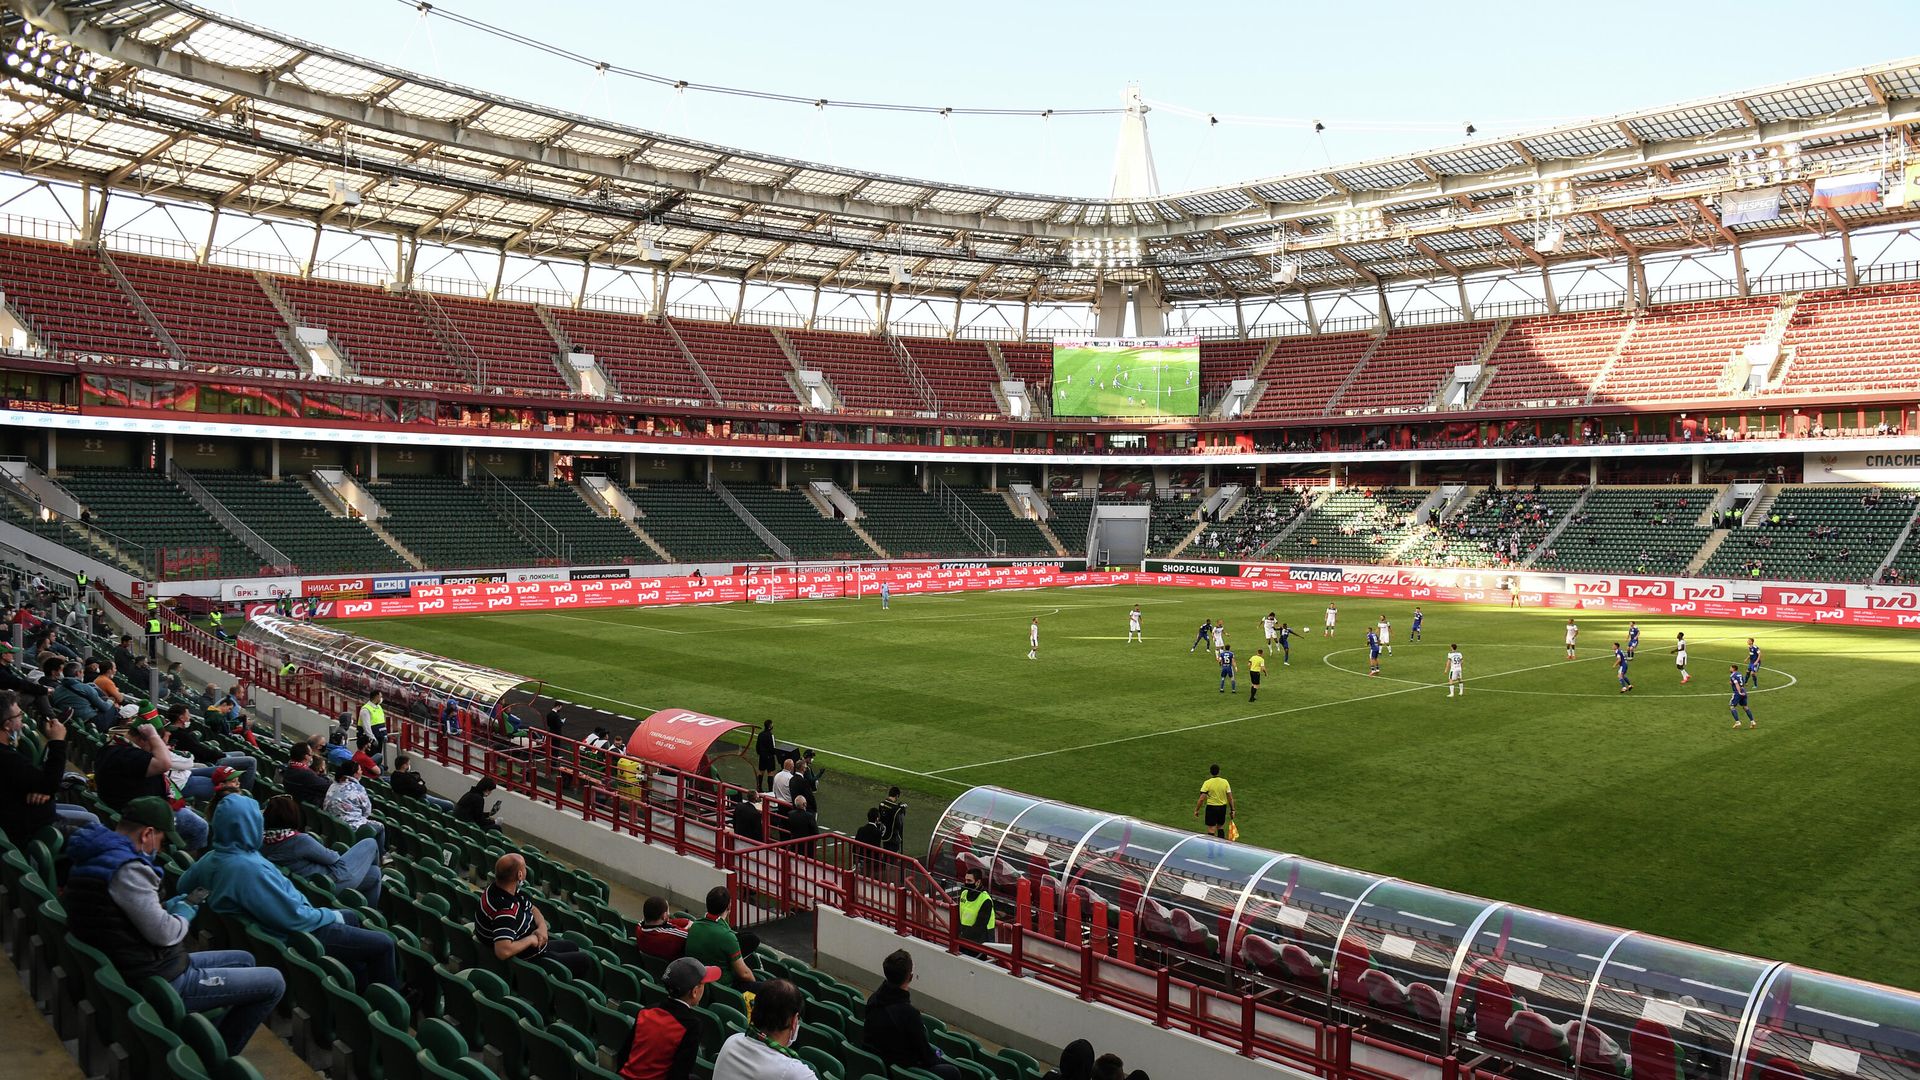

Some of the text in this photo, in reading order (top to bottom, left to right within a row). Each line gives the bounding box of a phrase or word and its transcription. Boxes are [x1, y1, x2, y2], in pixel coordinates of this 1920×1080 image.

[1737, 199, 1777, 210] RESPECT
[1162, 564, 1220, 575] SHOP.FCLM.RU
[443, 576, 506, 585] SPORT24.RU
[1342, 573, 1395, 585] САПСАН
[307, 584, 334, 592] НИИАС
[250, 602, 333, 618] САСН
[1453, 656, 1460, 665] 59
